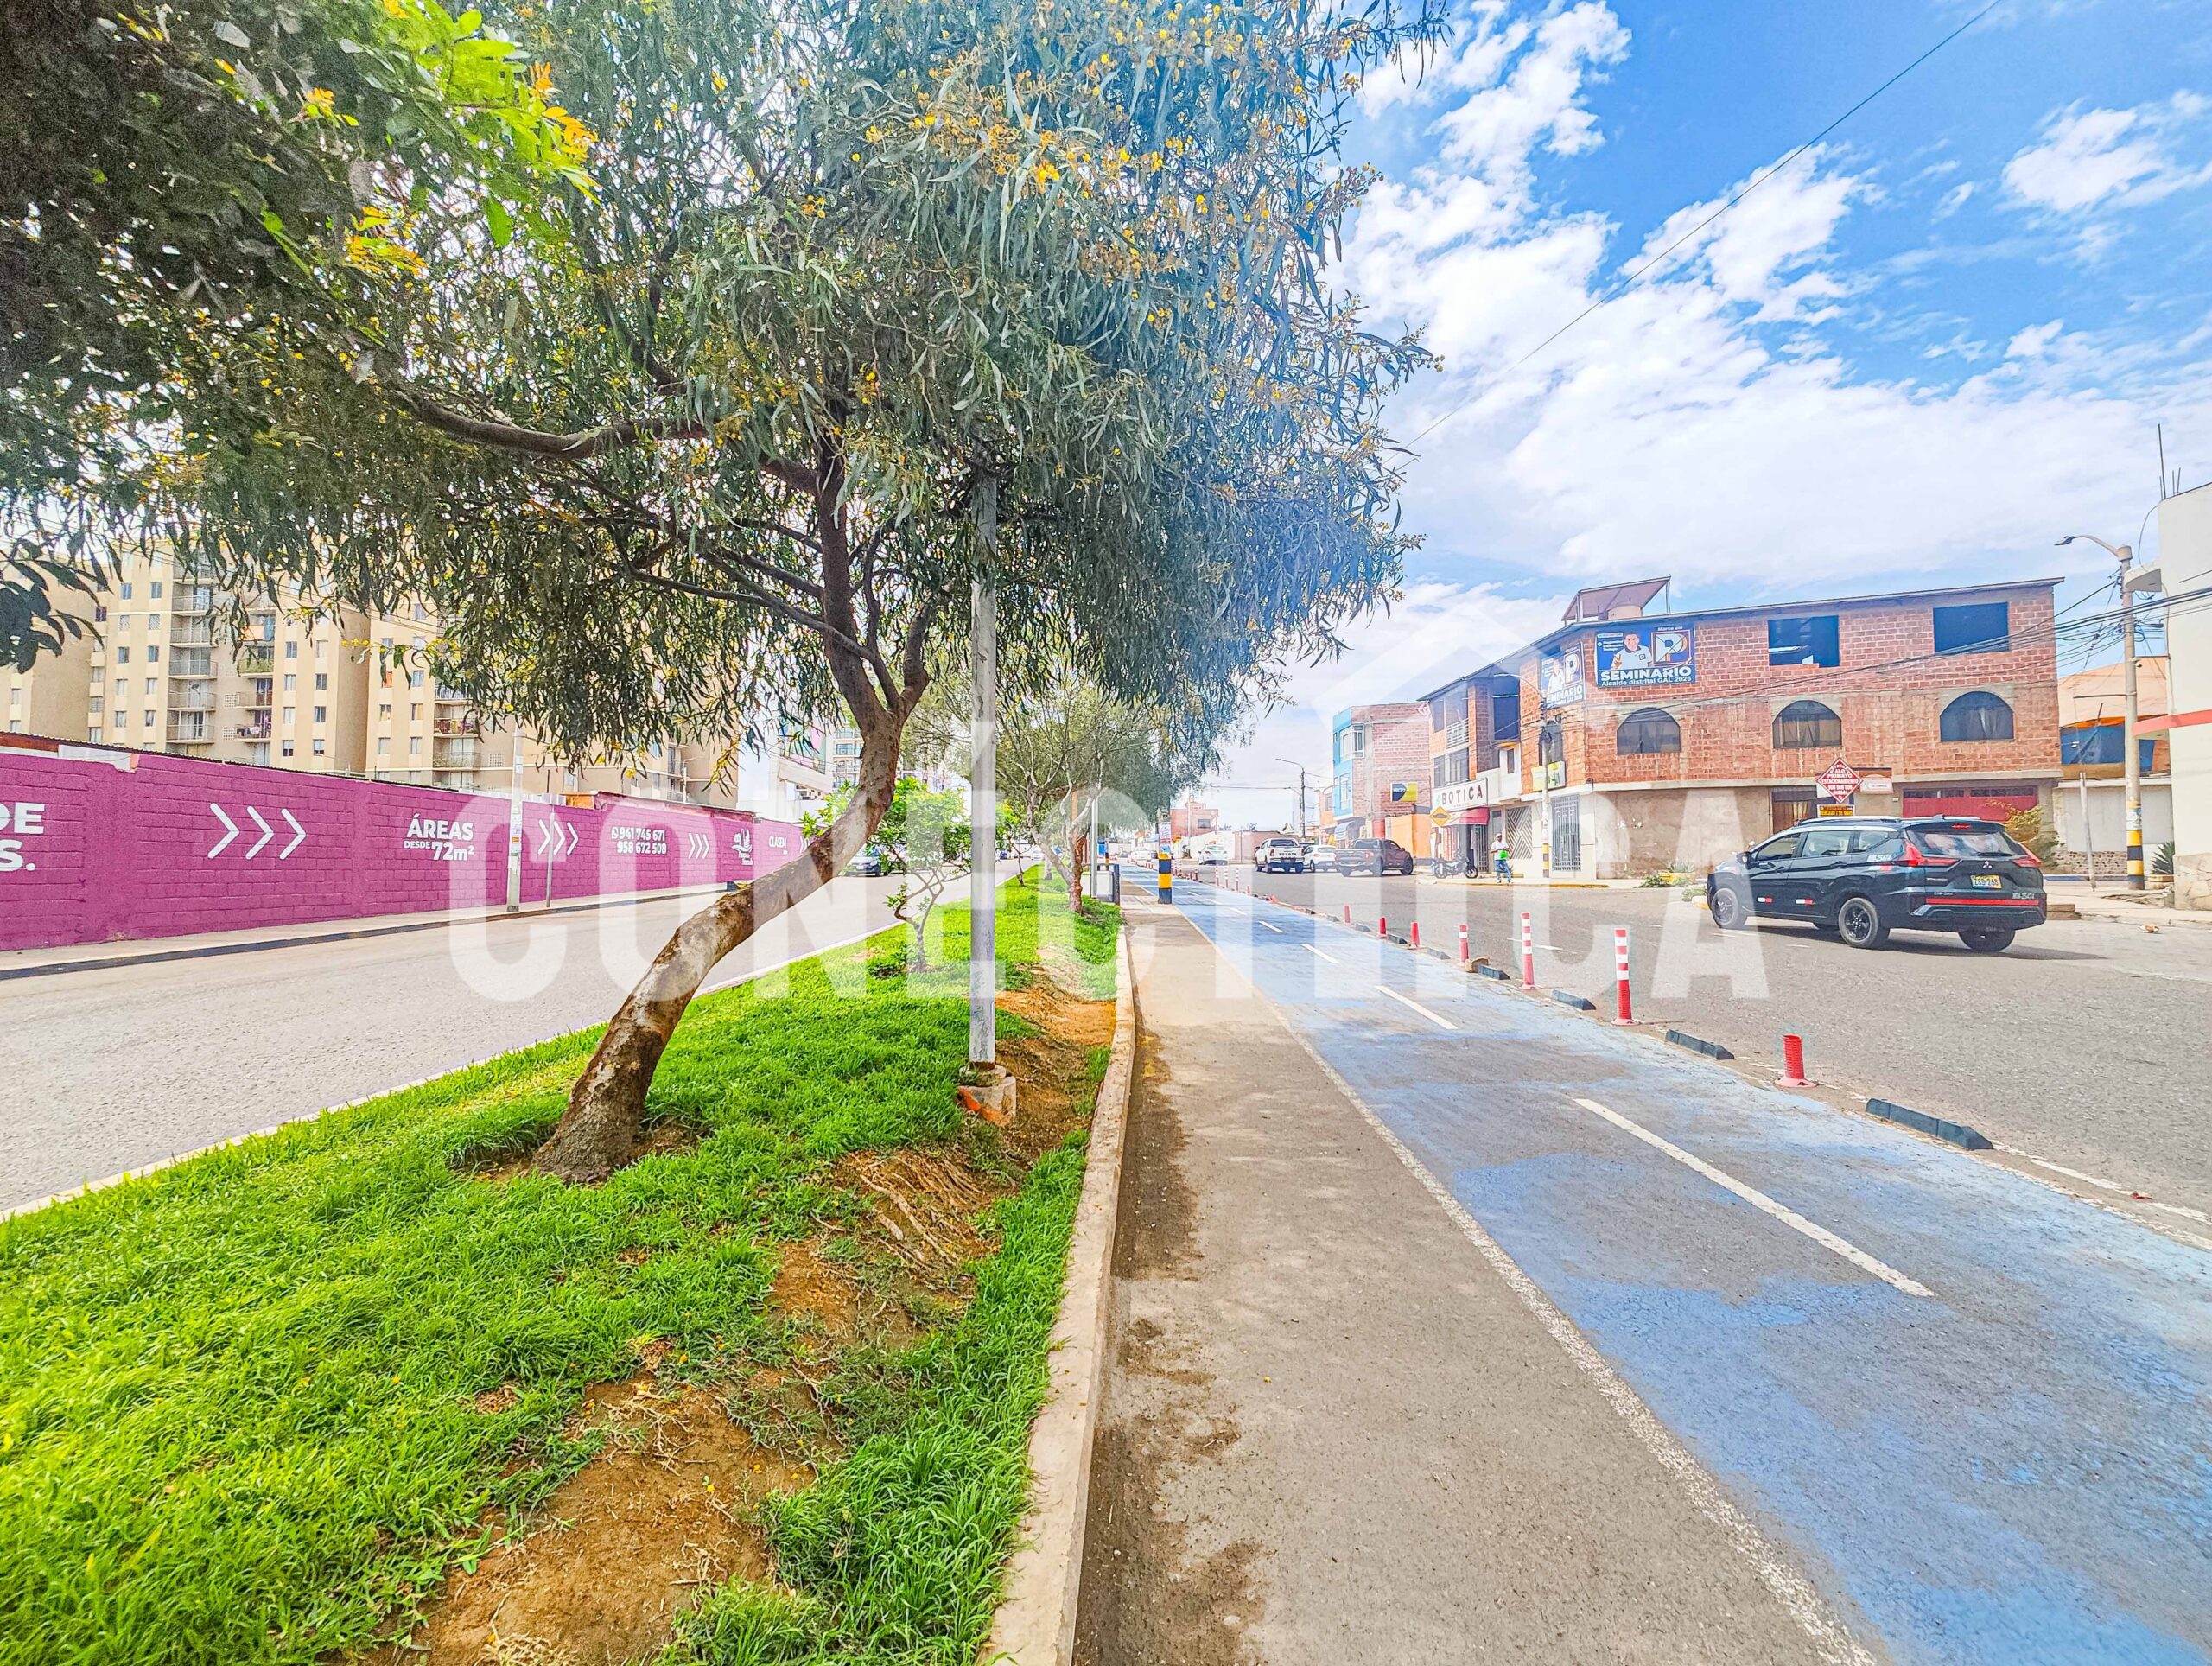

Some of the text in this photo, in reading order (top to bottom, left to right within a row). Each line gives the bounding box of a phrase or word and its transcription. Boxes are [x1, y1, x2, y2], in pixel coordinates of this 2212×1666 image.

[1601, 666, 1692, 681] SEMINARIO
[1442, 785, 1483, 805] BOTICA
[406, 813, 474, 841] ÁREAS
[620, 827, 665, 842] 941 745 671
[404, 841, 431, 849] DESDE
[616, 840, 634, 854] 958
[635, 841, 651, 854] 672
